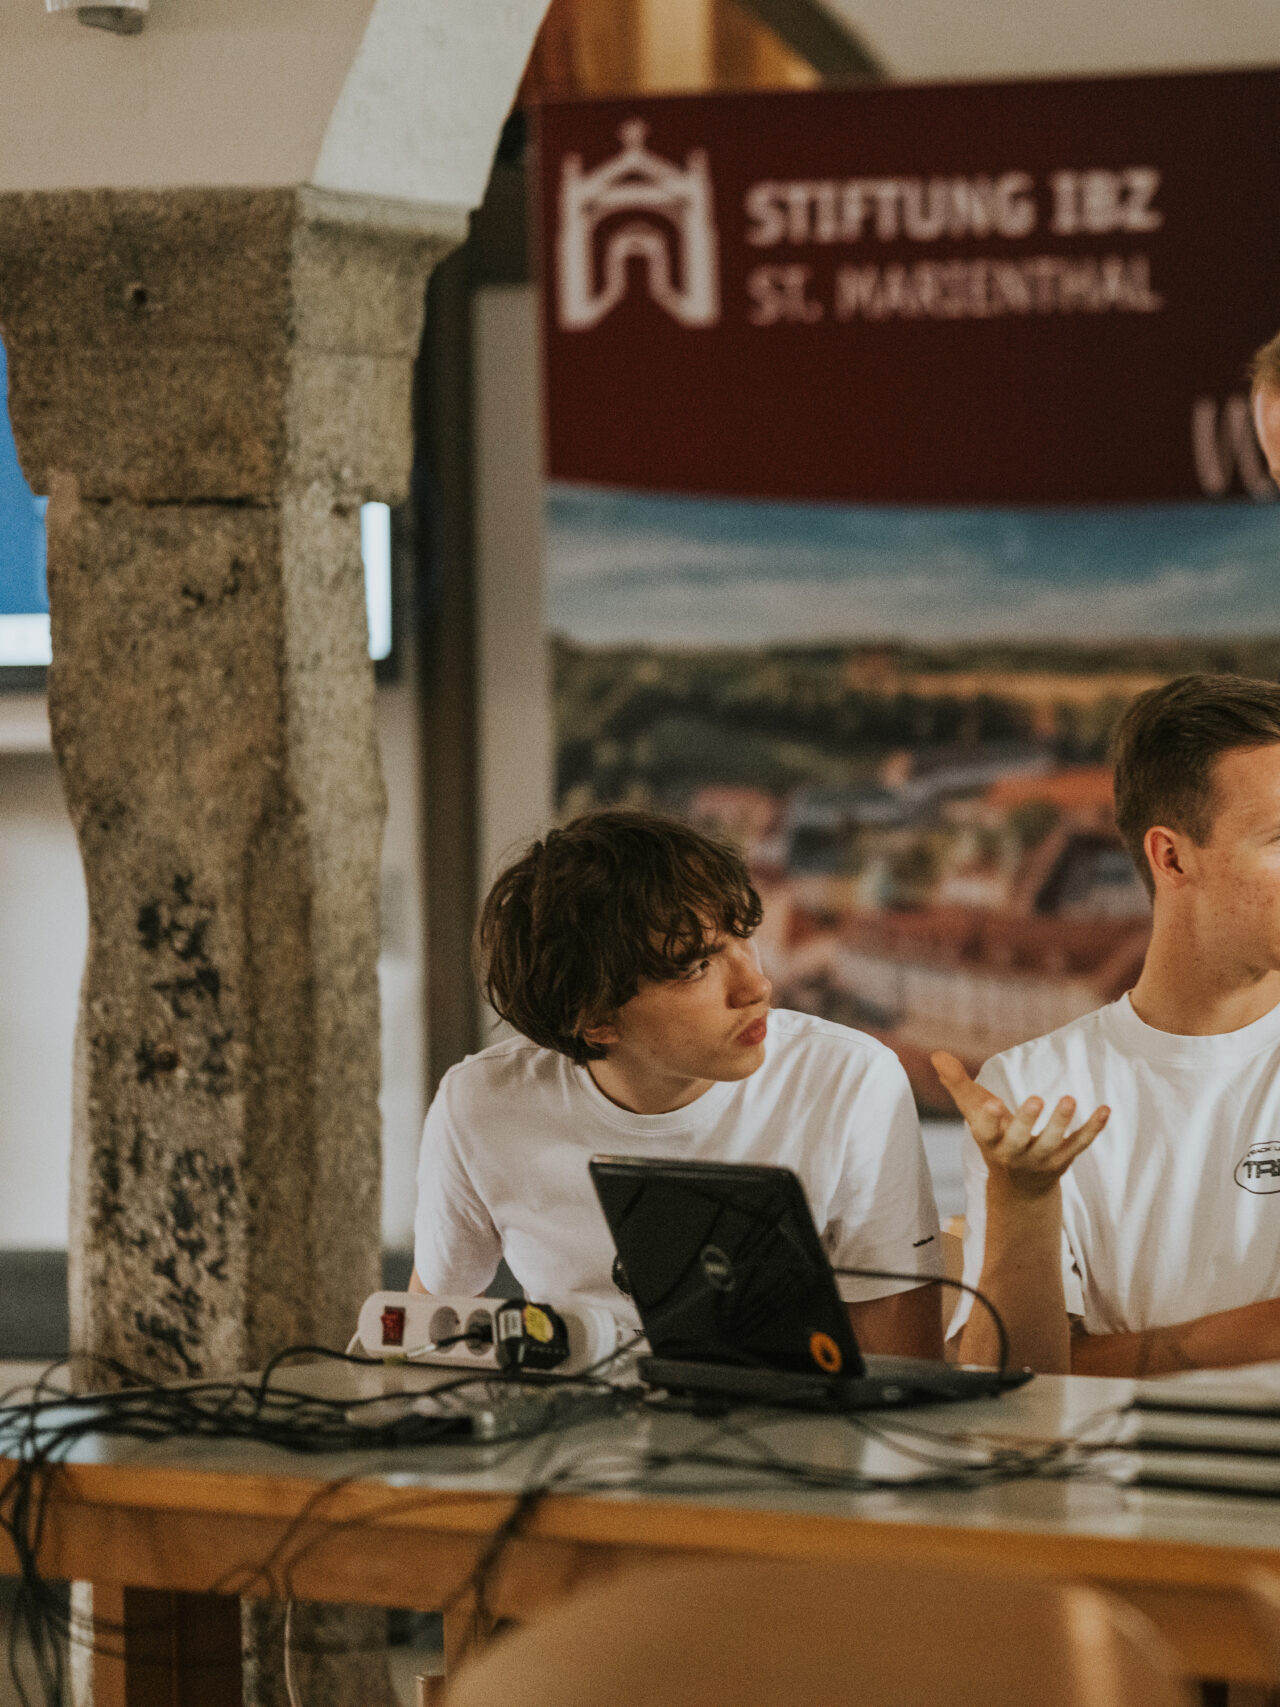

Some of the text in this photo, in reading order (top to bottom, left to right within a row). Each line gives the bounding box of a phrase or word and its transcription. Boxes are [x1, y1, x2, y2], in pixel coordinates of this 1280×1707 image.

[747, 166, 1162, 246] STIFTUNG IBZ
[747, 256, 1164, 325] ST. MARIENTHAL
